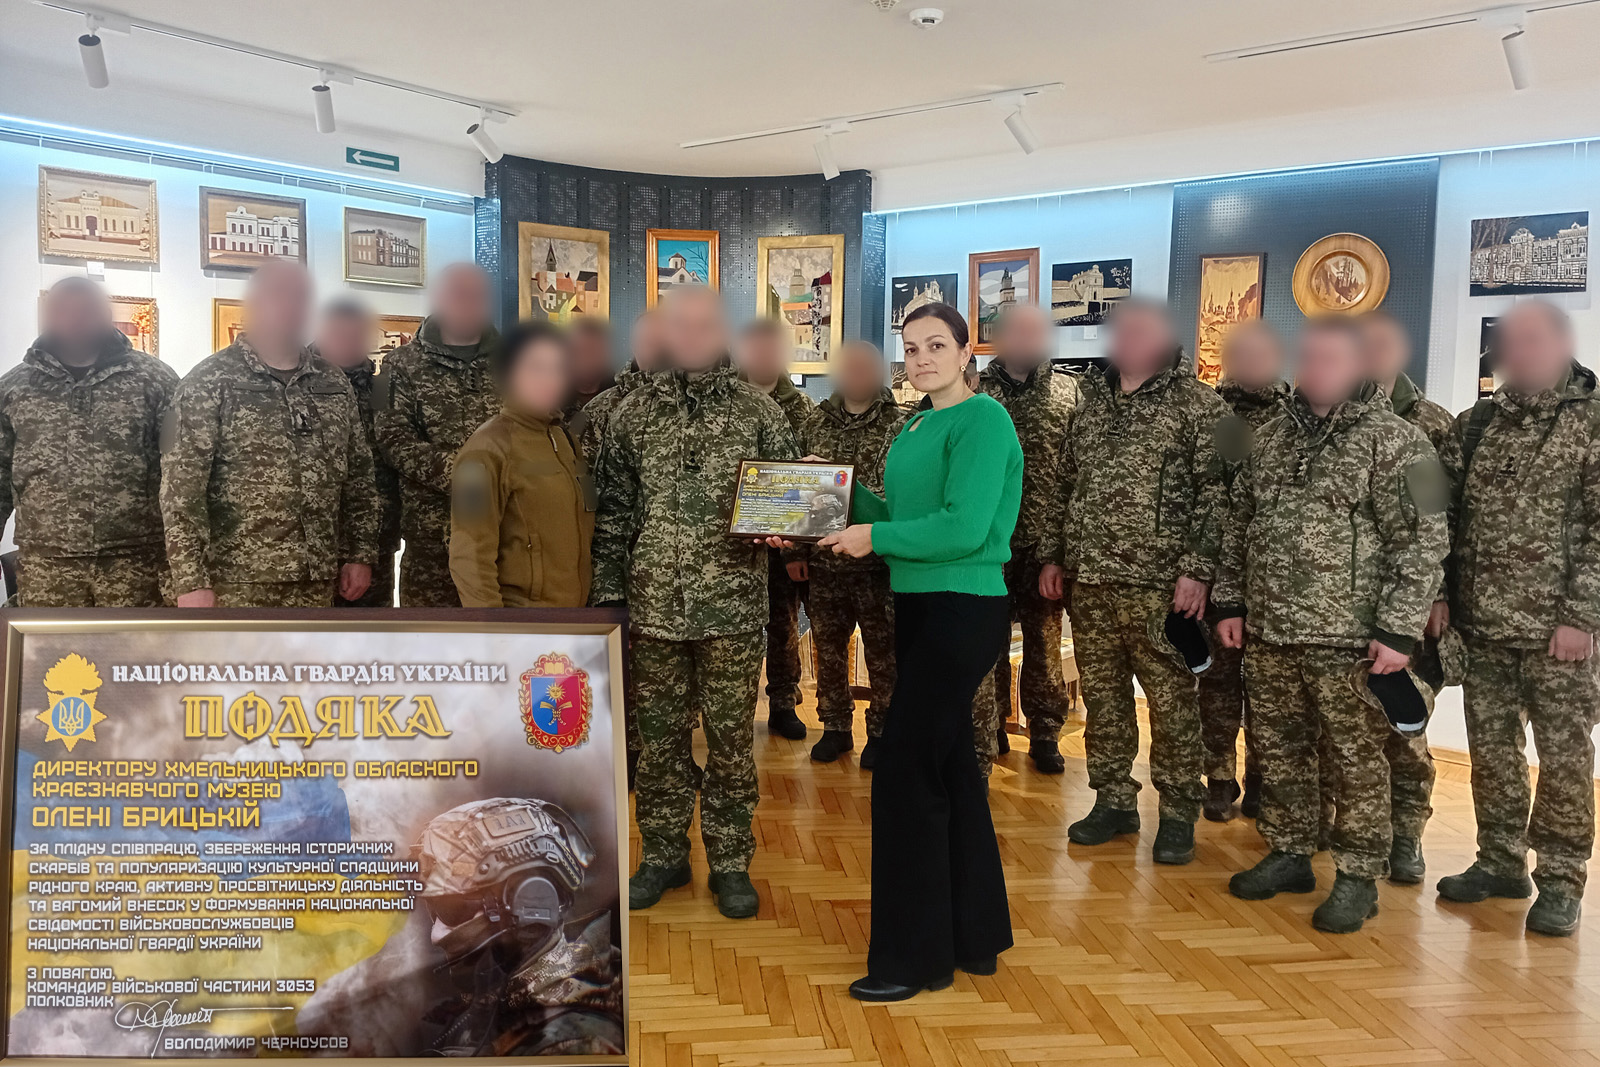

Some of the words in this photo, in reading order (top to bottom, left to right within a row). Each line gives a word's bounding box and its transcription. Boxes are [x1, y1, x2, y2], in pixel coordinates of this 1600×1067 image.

[112, 662, 288, 684] НАЦІОНАЛЬНА
[293, 662, 396, 684] ГВАРДІЯ
[400, 662, 507, 682] УКРАЇНИ
[181, 691, 452, 747] ПОДЯКА
[33, 761, 157, 779] ДИРЕКТОРУ
[165, 761, 346, 780] ХМЕЛЬНИЦЬКОГО
[355, 761, 478, 777] ОБЛАСНОГО
[33, 781, 198, 798] КРАЄЗНАВЧОГО
[207, 782, 281, 798] МУЗЕЮ
[32, 806, 111, 827] ОЛЕНІ
[123, 800, 260, 831] БРИЦЬКІЙ
[29, 843, 49, 855] ЗА
[54, 843, 106, 857] ПЛІДНУ
[111, 843, 200, 857] СПІВПРАЦЮ,
[204, 843, 301, 855] ЗБЕРЕЖЕННЯ
[306, 842, 393, 854] ІСТОРИЧНИХ
[29, 862, 91, 874] СКАРБІВ
[96, 862, 114, 874] ТА
[120, 861, 243, 875] ПОПУЛЯРИЗАЦІЮ
[248, 859, 335, 873] КУЛЬТУРНОЇ
[339, 861, 419, 874] СПАДЩИНИ
[28, 881, 90, 894] РІДНОГО
[95, 881, 141, 894] КРАЮ,
[146, 881, 213, 893] АКТИВНУ
[218, 880, 336, 893] ПРОСВІТНИЦЬКУ
[340, 880, 423, 893] ДІЯЛЬНІСТЬ
[28, 900, 47, 912] ТА
[52, 896, 122, 912] ВАГОМИЙ
[127, 899, 186, 911] ВНЕСОК
[191, 899, 200, 911] У
[205, 899, 305, 911] ФОРМУВАННЯ
[310, 896, 415, 912] НАЦІОНАЛЬНОЇ
[28, 919, 114, 932] СВІДОМОСТІ
[119, 915, 294, 931] ВІЙСЬКОВОСЛУЖБОВЦІВ
[28, 935, 134, 951] НАЦІОНАЛЬНОЇ
[139, 934, 196, 951] ГВАРДІЇ
[199, 934, 262, 949] УКРАЇНИ
[27, 967, 37, 979] З
[42, 967, 116, 981] ПОВАГОЮ,
[27, 980, 106, 995] КОМАНДИР
[111, 977, 199, 993] ВІЙСЬКОВОЇ
[203, 980, 271, 993] ЧАСТИНИ
[276, 980, 315, 992] 3053
[27, 995, 114, 1008] ПОЛКОВНИК
[164, 1037, 256, 1050] ВОЛОДИМИР
[261, 1037, 349, 1049] ЧЕРНОУСОВ
